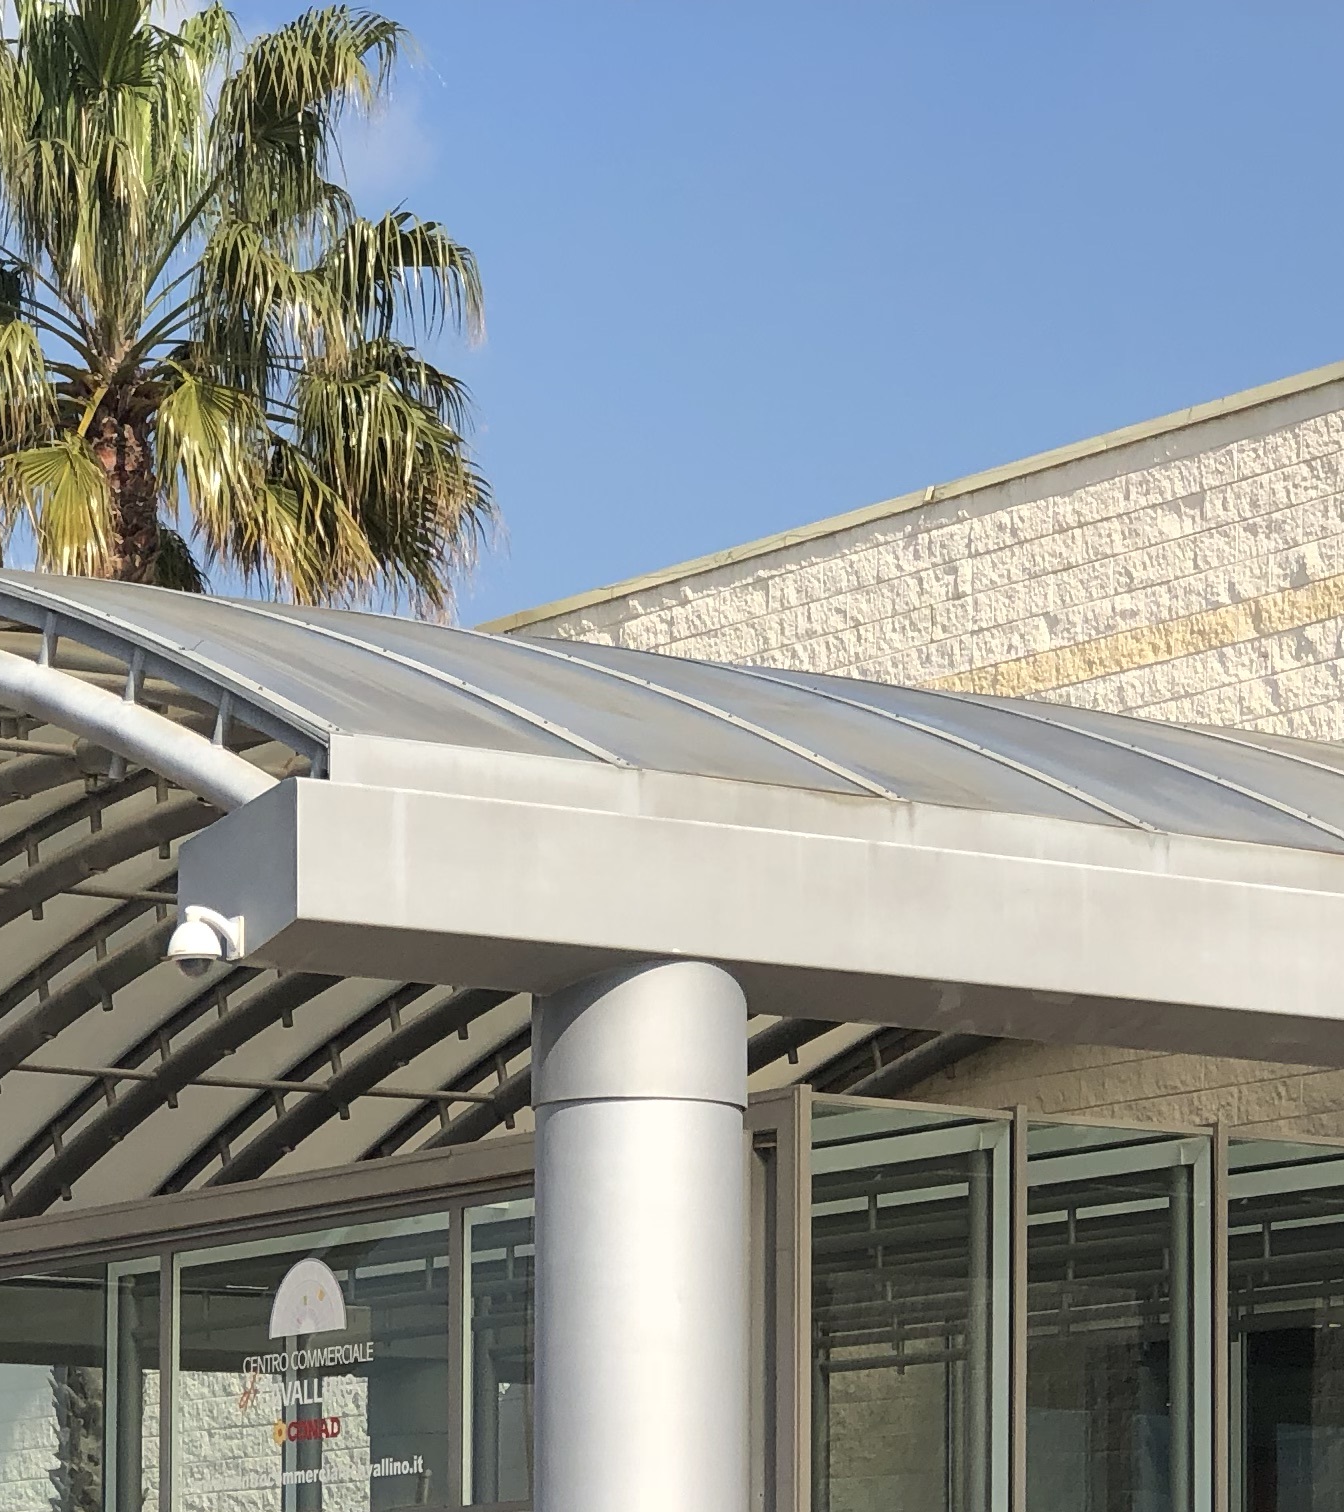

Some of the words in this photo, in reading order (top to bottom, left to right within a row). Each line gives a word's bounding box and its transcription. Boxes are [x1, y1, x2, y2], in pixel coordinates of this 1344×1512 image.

[243, 1353, 288, 1375] CENTRO
[291, 1342, 374, 1371] COMMERCIALE
[287, 1417, 341, 1442] CONAD
